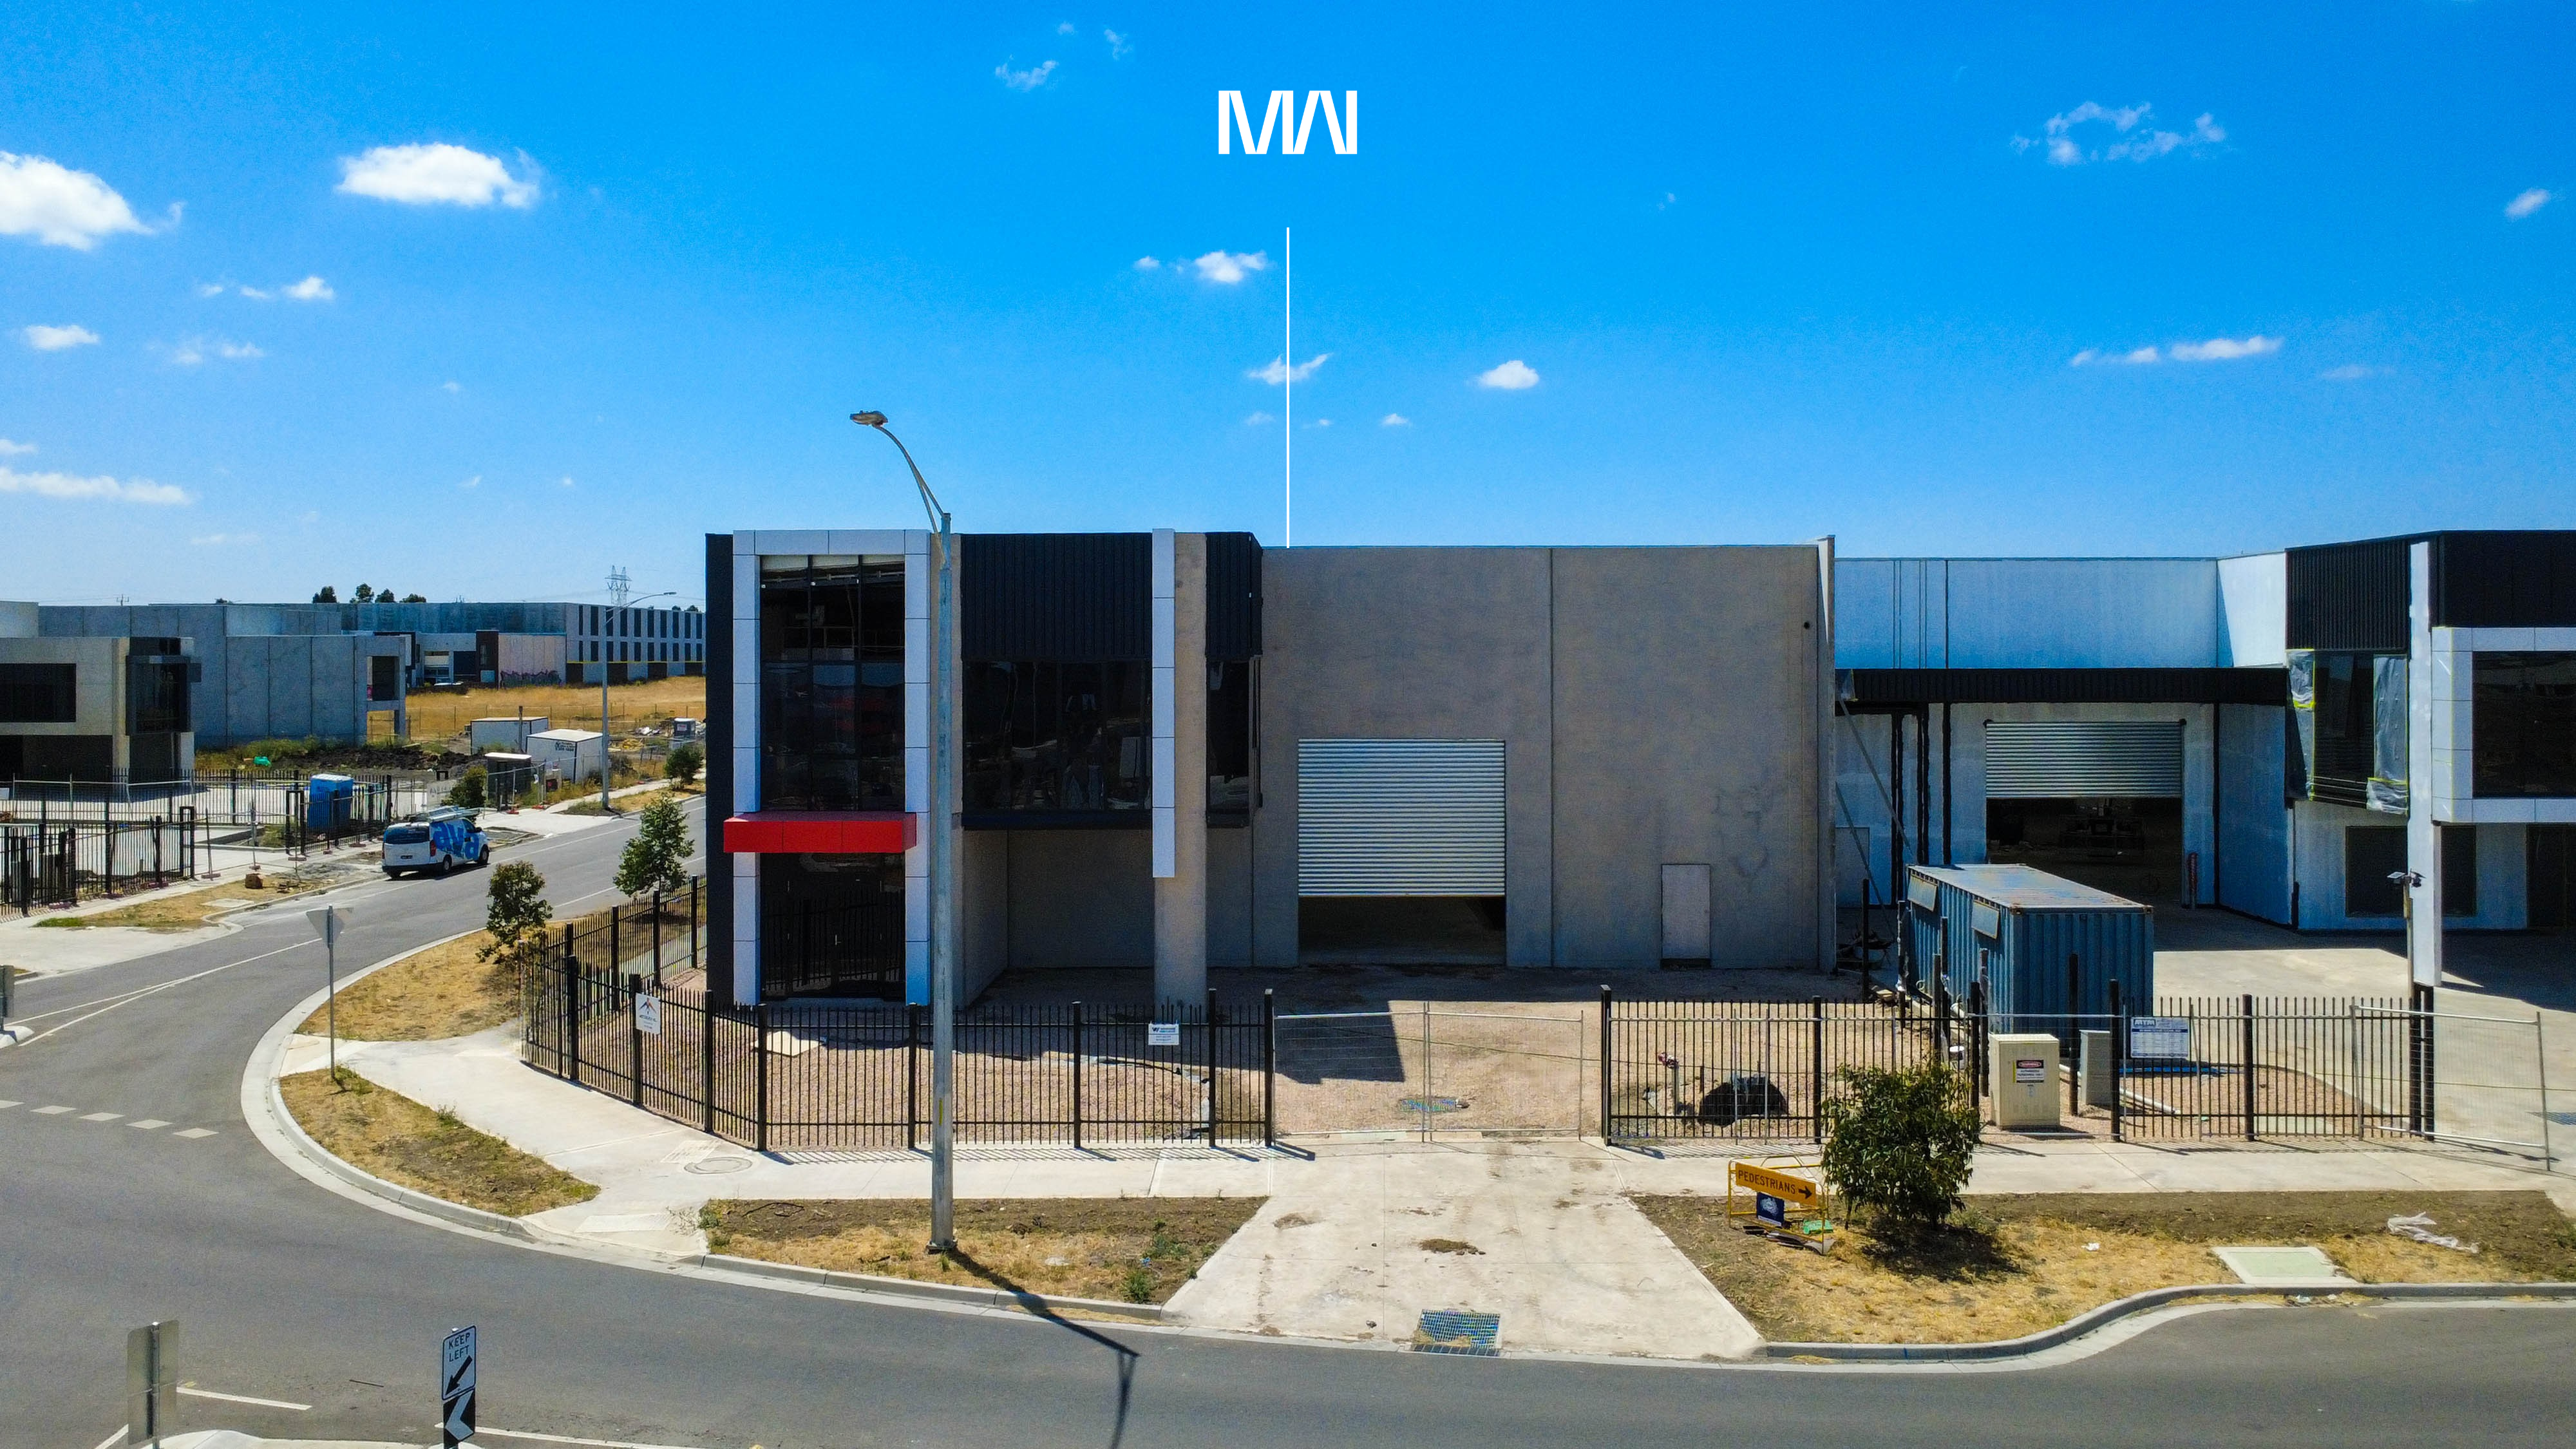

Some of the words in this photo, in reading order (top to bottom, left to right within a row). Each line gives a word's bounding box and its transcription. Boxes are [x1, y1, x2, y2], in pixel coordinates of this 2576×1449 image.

[1738, 1170, 1796, 1195] PEDESTRIANS
[448, 1332, 471, 1350] KEEP
[449, 1345, 469, 1362] LEFT
